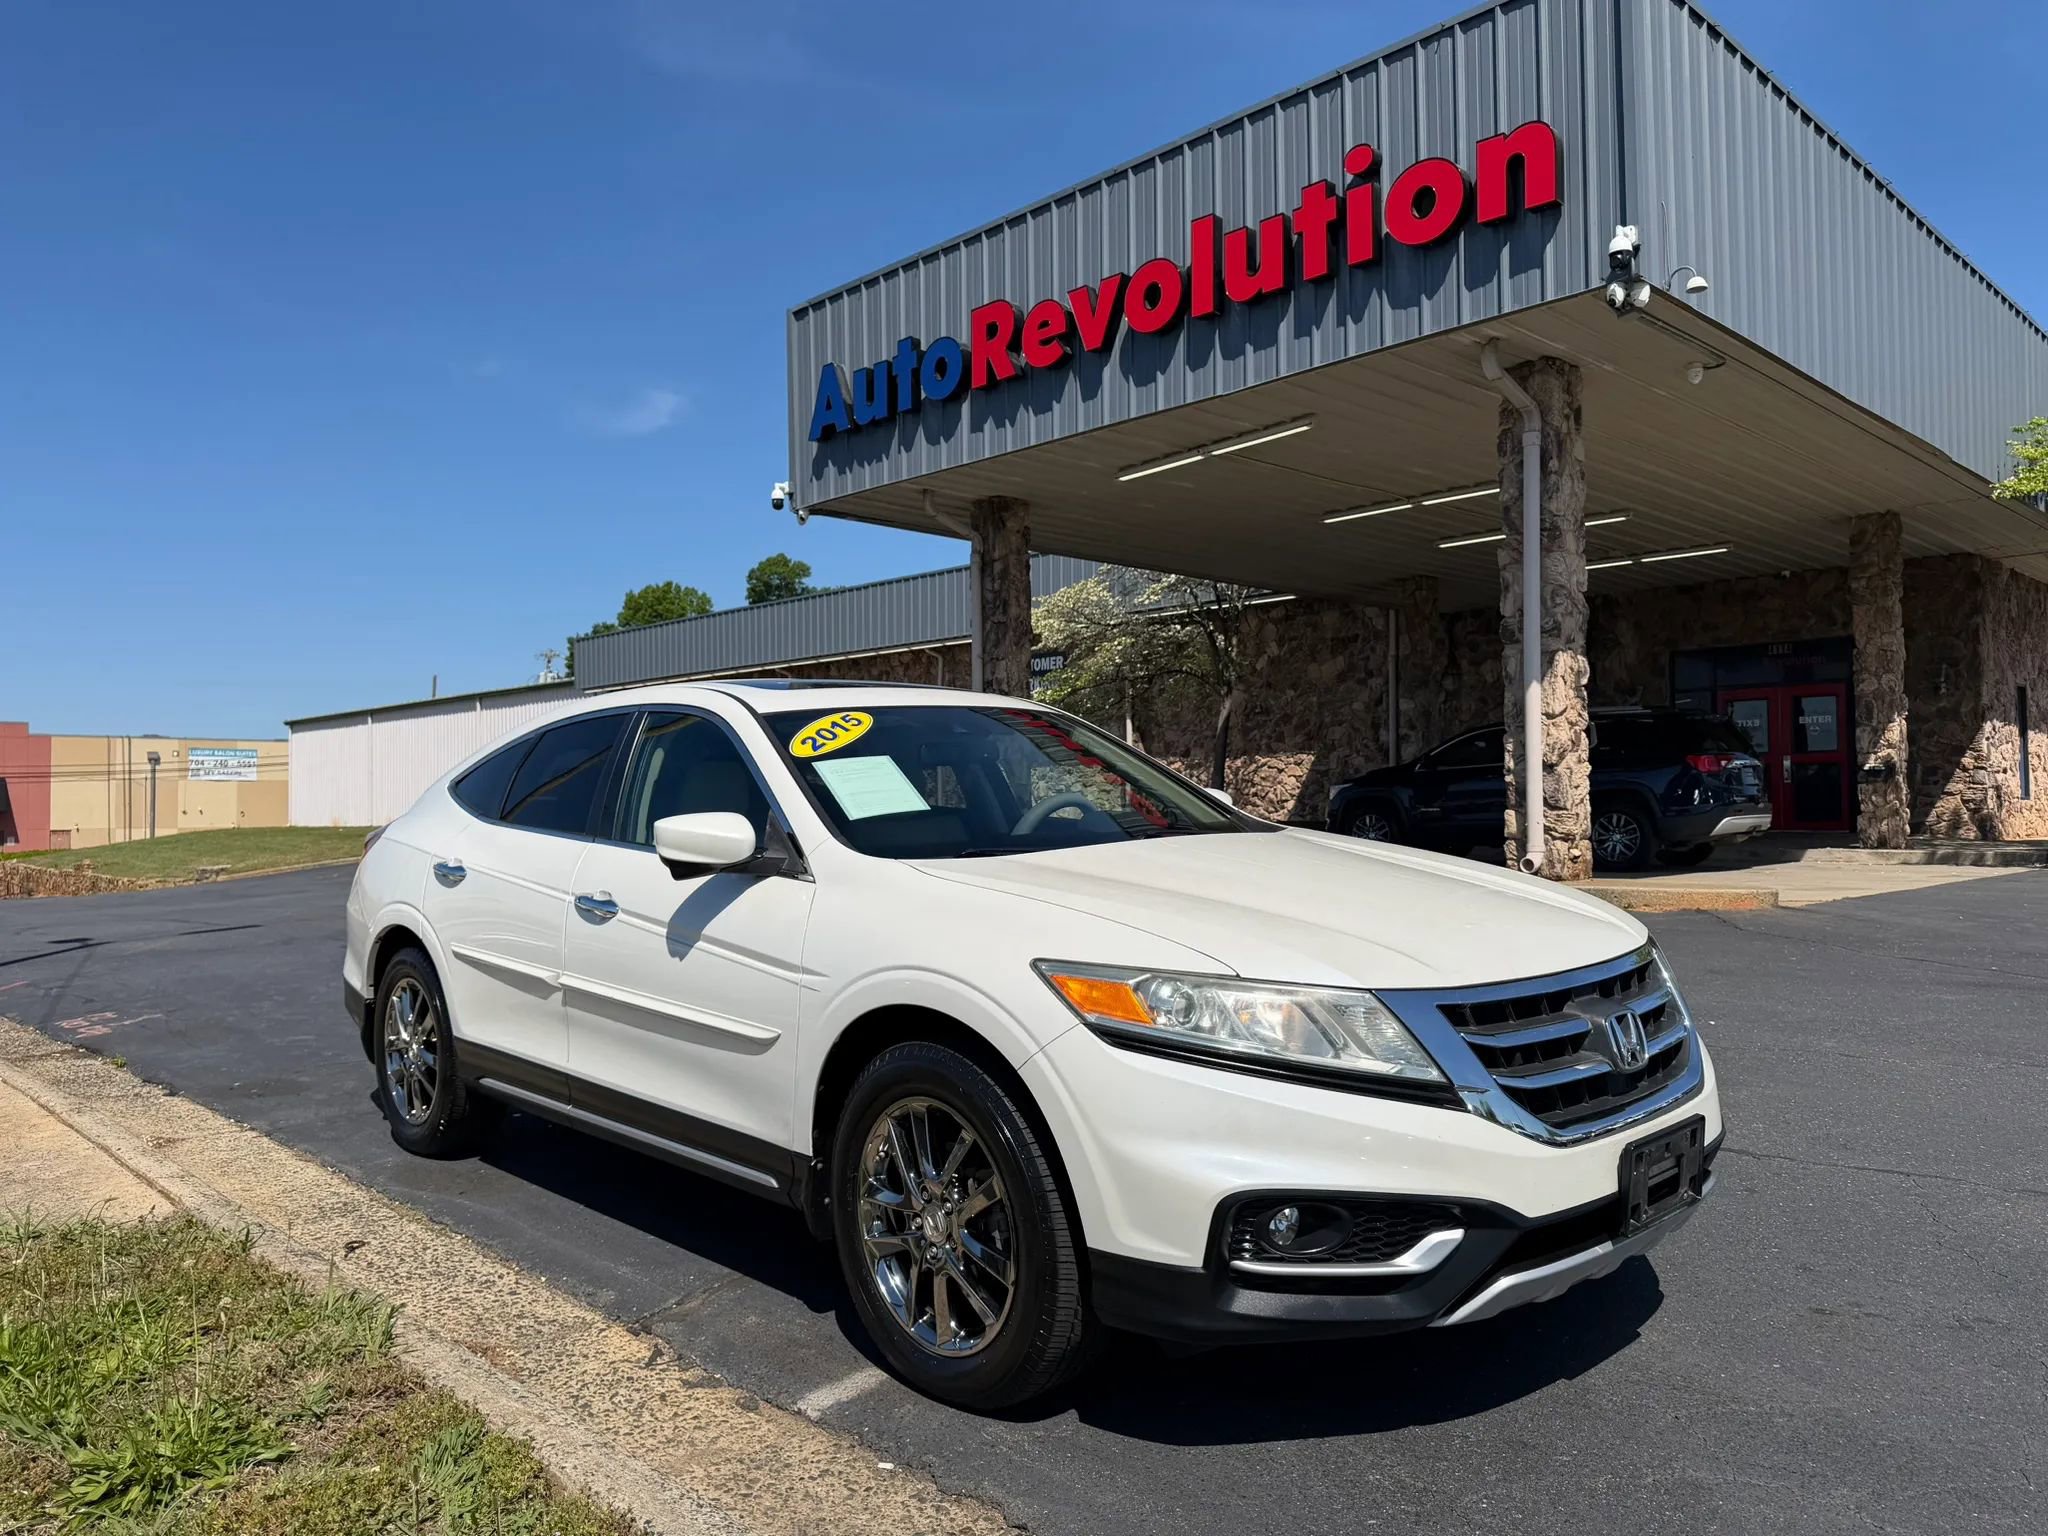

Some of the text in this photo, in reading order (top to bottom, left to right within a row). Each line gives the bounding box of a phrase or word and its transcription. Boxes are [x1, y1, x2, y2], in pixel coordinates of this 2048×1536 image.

[808, 119, 1561, 441] AutoRevolution
[800, 714, 863, 752] 2015
[1799, 715, 1832, 724] ENTER
